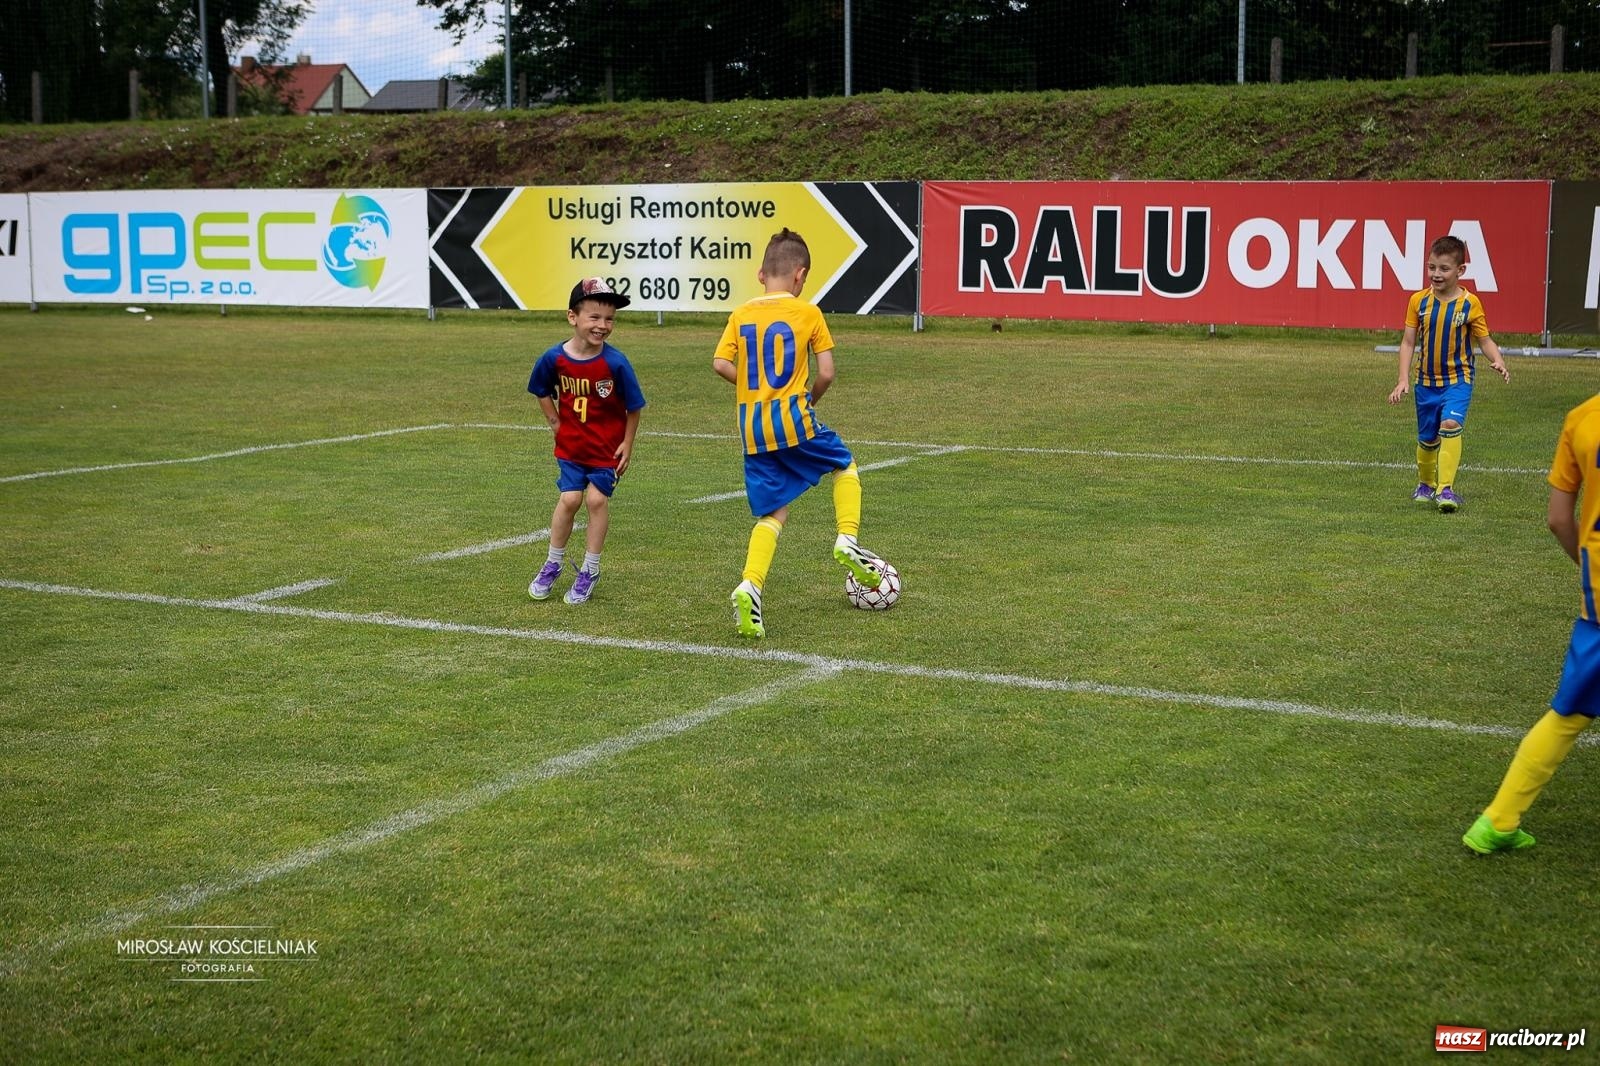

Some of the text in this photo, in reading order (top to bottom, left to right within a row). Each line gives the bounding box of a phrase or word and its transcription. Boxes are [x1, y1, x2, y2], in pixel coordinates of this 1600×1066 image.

[548, 195, 776, 225] Usługi Remontowe
[571, 236, 752, 265] Krzysztof Kaim
[958, 204, 1211, 299] RALU
[1227, 216, 1498, 293] OKNA
[147, 275, 195, 300] Sp.
[601, 277, 731, 300] 82 680 799
[740, 320, 797, 390] 10
[558, 374, 590, 396] PAIN
[573, 396, 588, 423] 9
